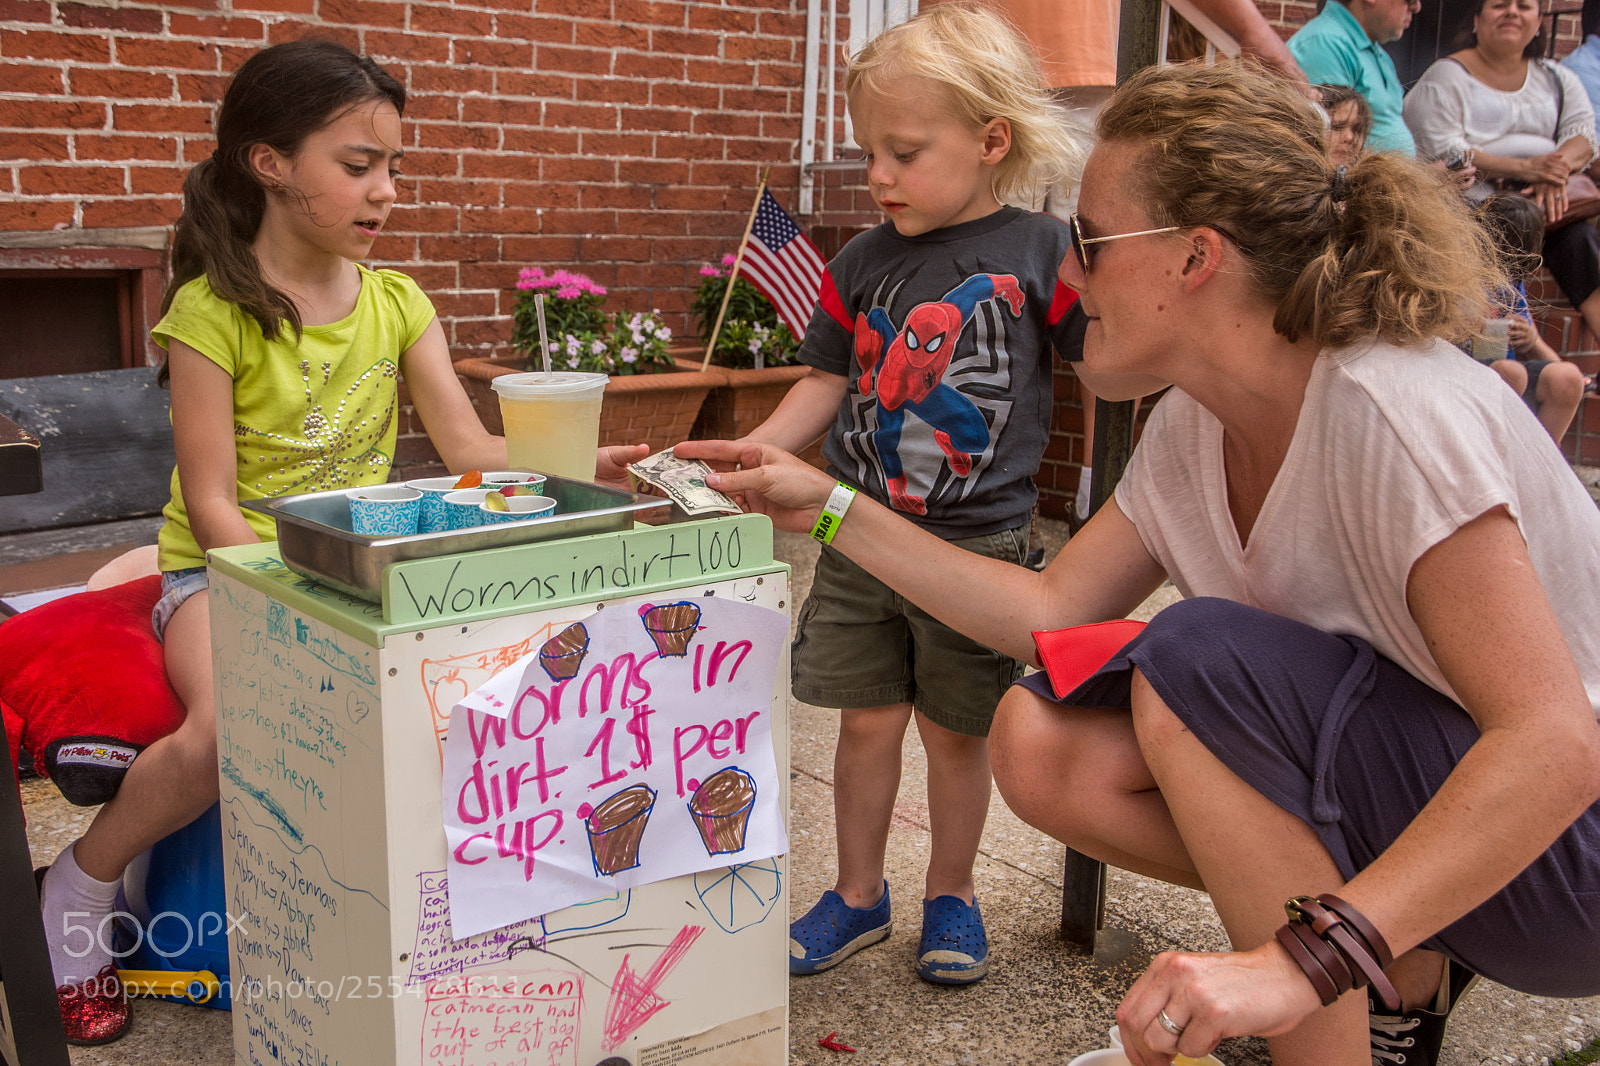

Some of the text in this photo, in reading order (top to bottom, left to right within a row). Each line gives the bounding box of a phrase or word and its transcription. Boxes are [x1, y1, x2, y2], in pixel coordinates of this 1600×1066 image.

[399, 560, 557, 619] Worms
[571, 556, 605, 594] in
[611, 533, 690, 589] dirt
[692, 626, 754, 695] in
[110, 751, 133, 763] Pets
[672, 711, 761, 799] per
[429, 1037, 473, 1058] out
[431, 1017, 480, 1040] the
